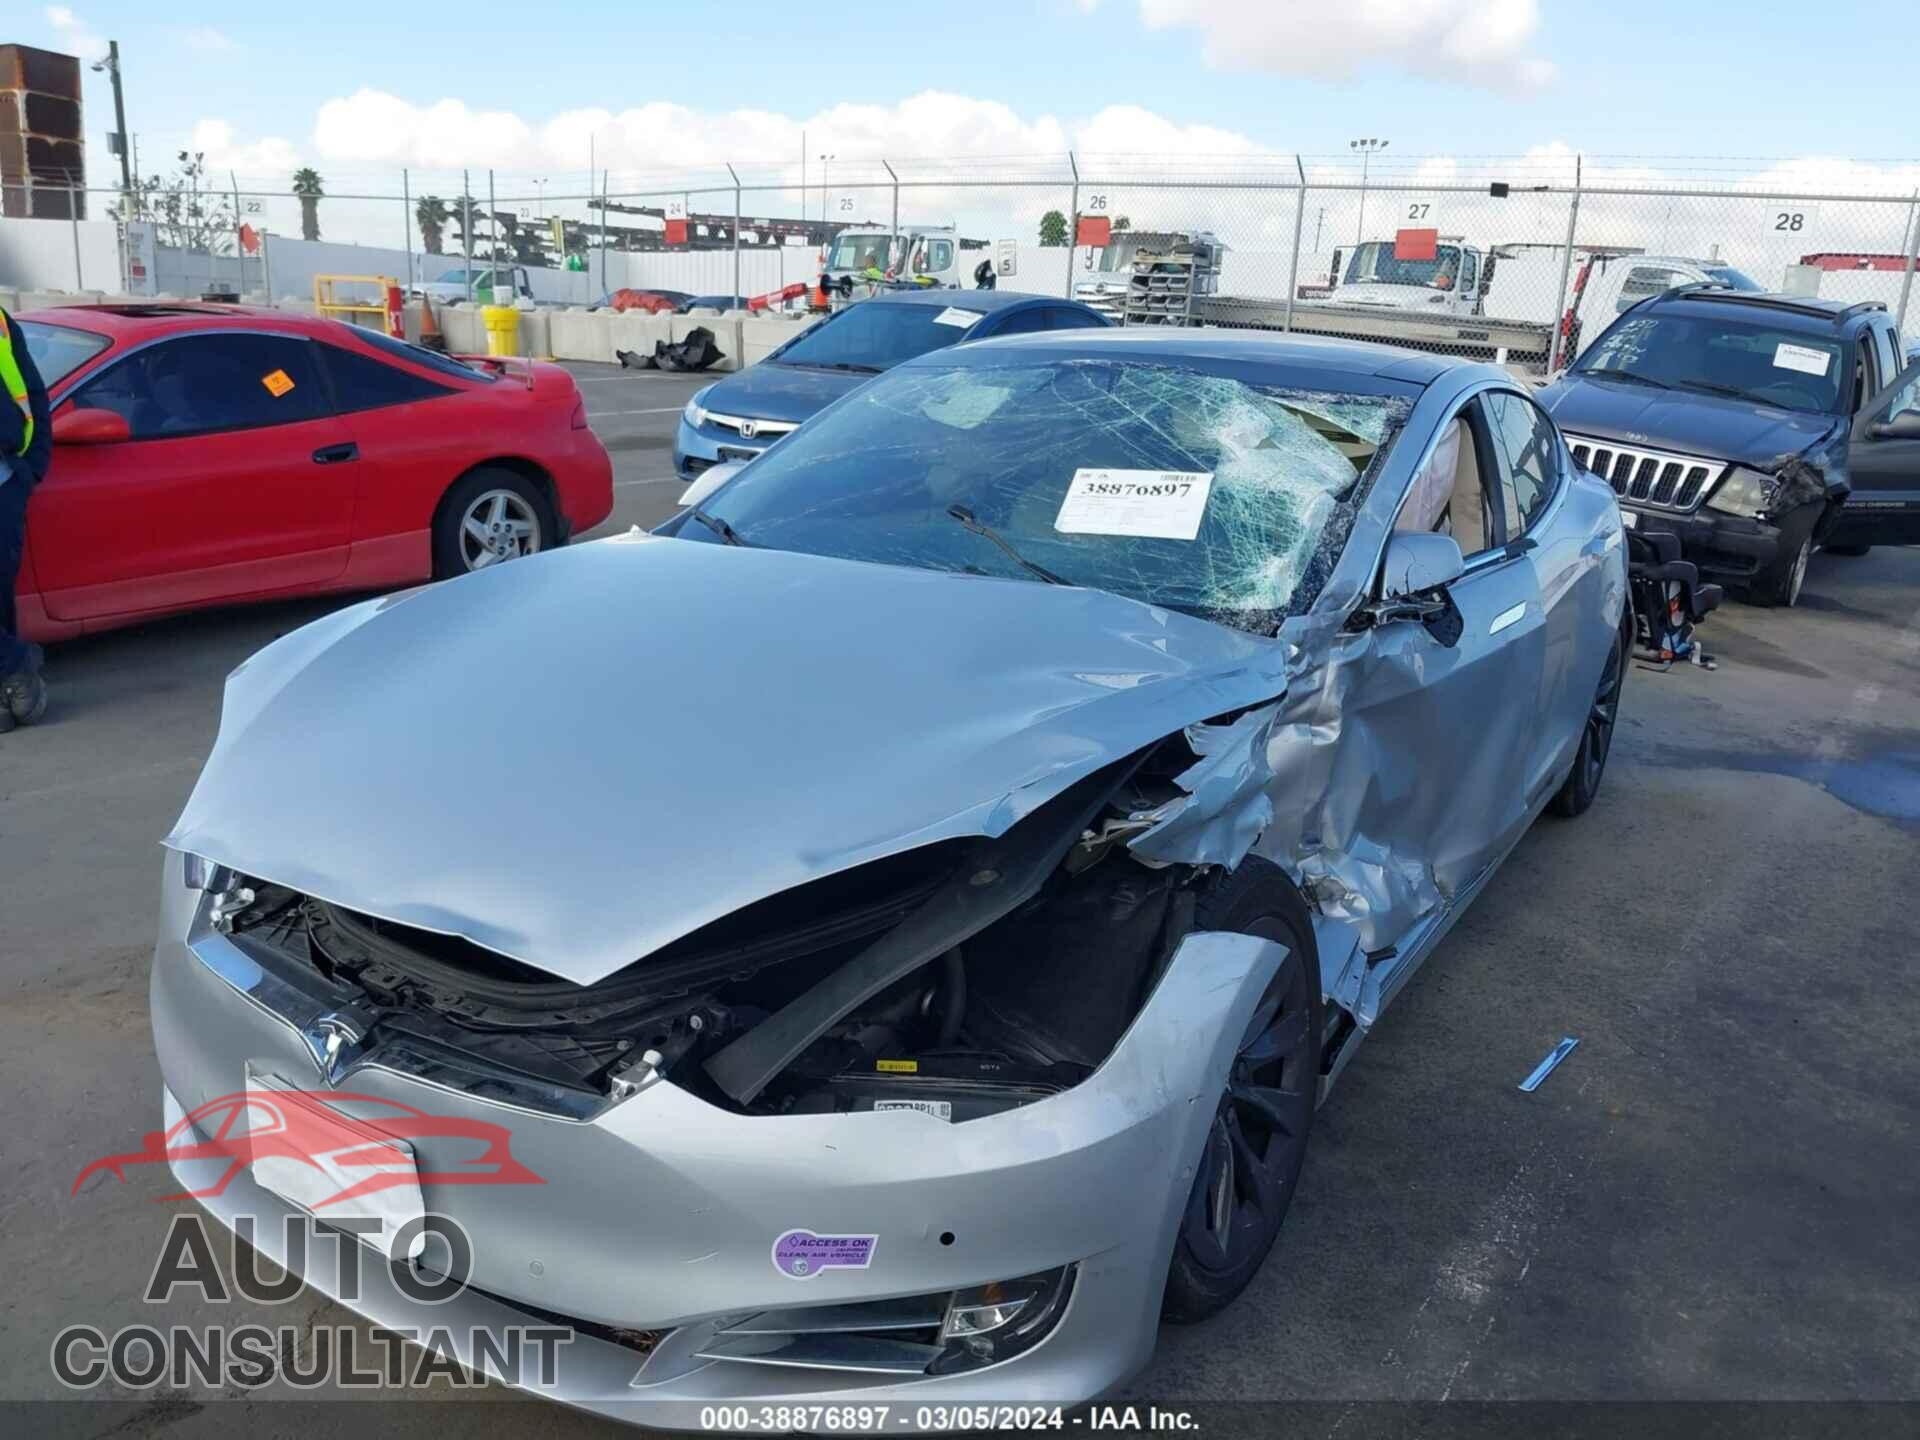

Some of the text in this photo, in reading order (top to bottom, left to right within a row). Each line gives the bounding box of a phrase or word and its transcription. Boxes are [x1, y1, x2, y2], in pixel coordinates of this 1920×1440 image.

[247, 202, 261, 213] 22
[840, 198, 854, 211] 25
[1090, 195, 1107, 209] 26
[1408, 203, 1431, 219] 27
[1774, 212, 1804, 231] 28
[1002, 259, 1010, 272] 5
[799, 1239, 871, 1247] ACCESS OK
